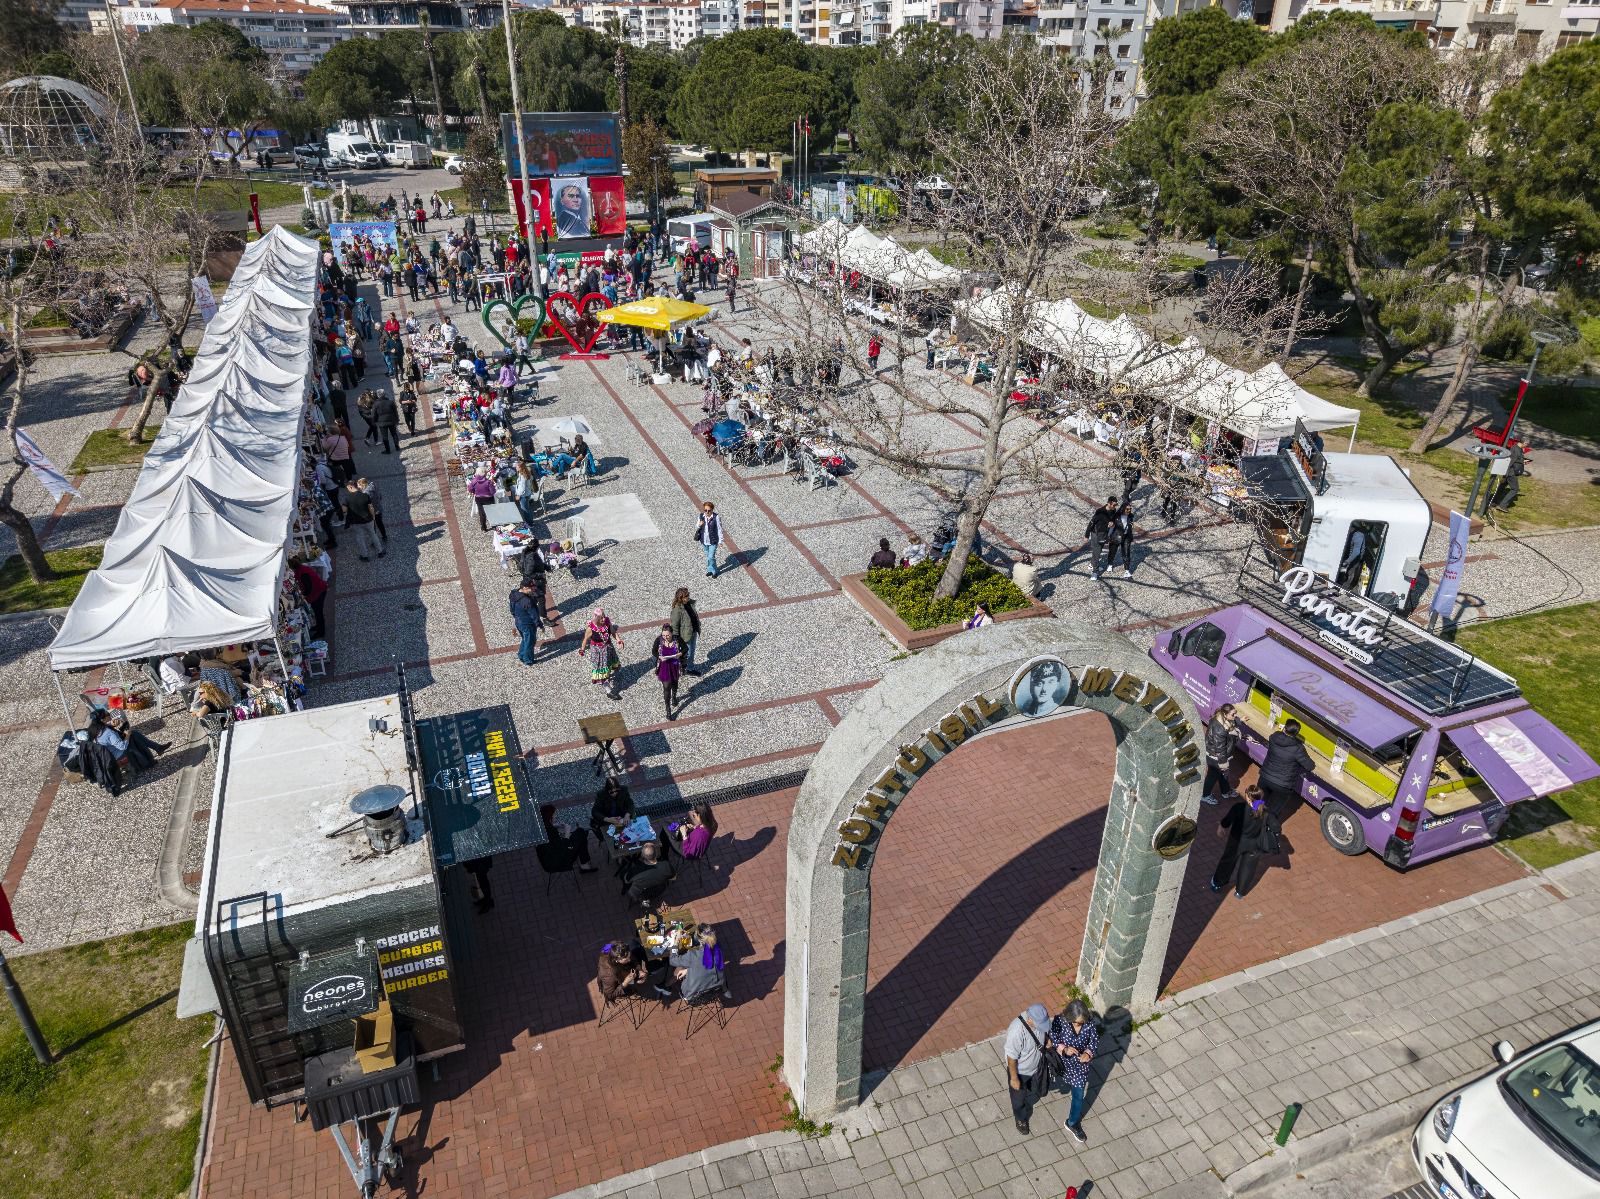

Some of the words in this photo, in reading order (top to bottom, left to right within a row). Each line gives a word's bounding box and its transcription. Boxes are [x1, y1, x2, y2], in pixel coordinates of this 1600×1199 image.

[1279, 566, 1383, 645] Panata
[1078, 664, 1202, 788] MEYDANI
[490, 761, 520, 813] LEZZET
[379, 940, 443, 964] BURGER
[382, 955, 446, 979] NEONES
[303, 979, 365, 1002] neones
[385, 969, 449, 994] BURGER
[316, 998, 351, 1011] burger
